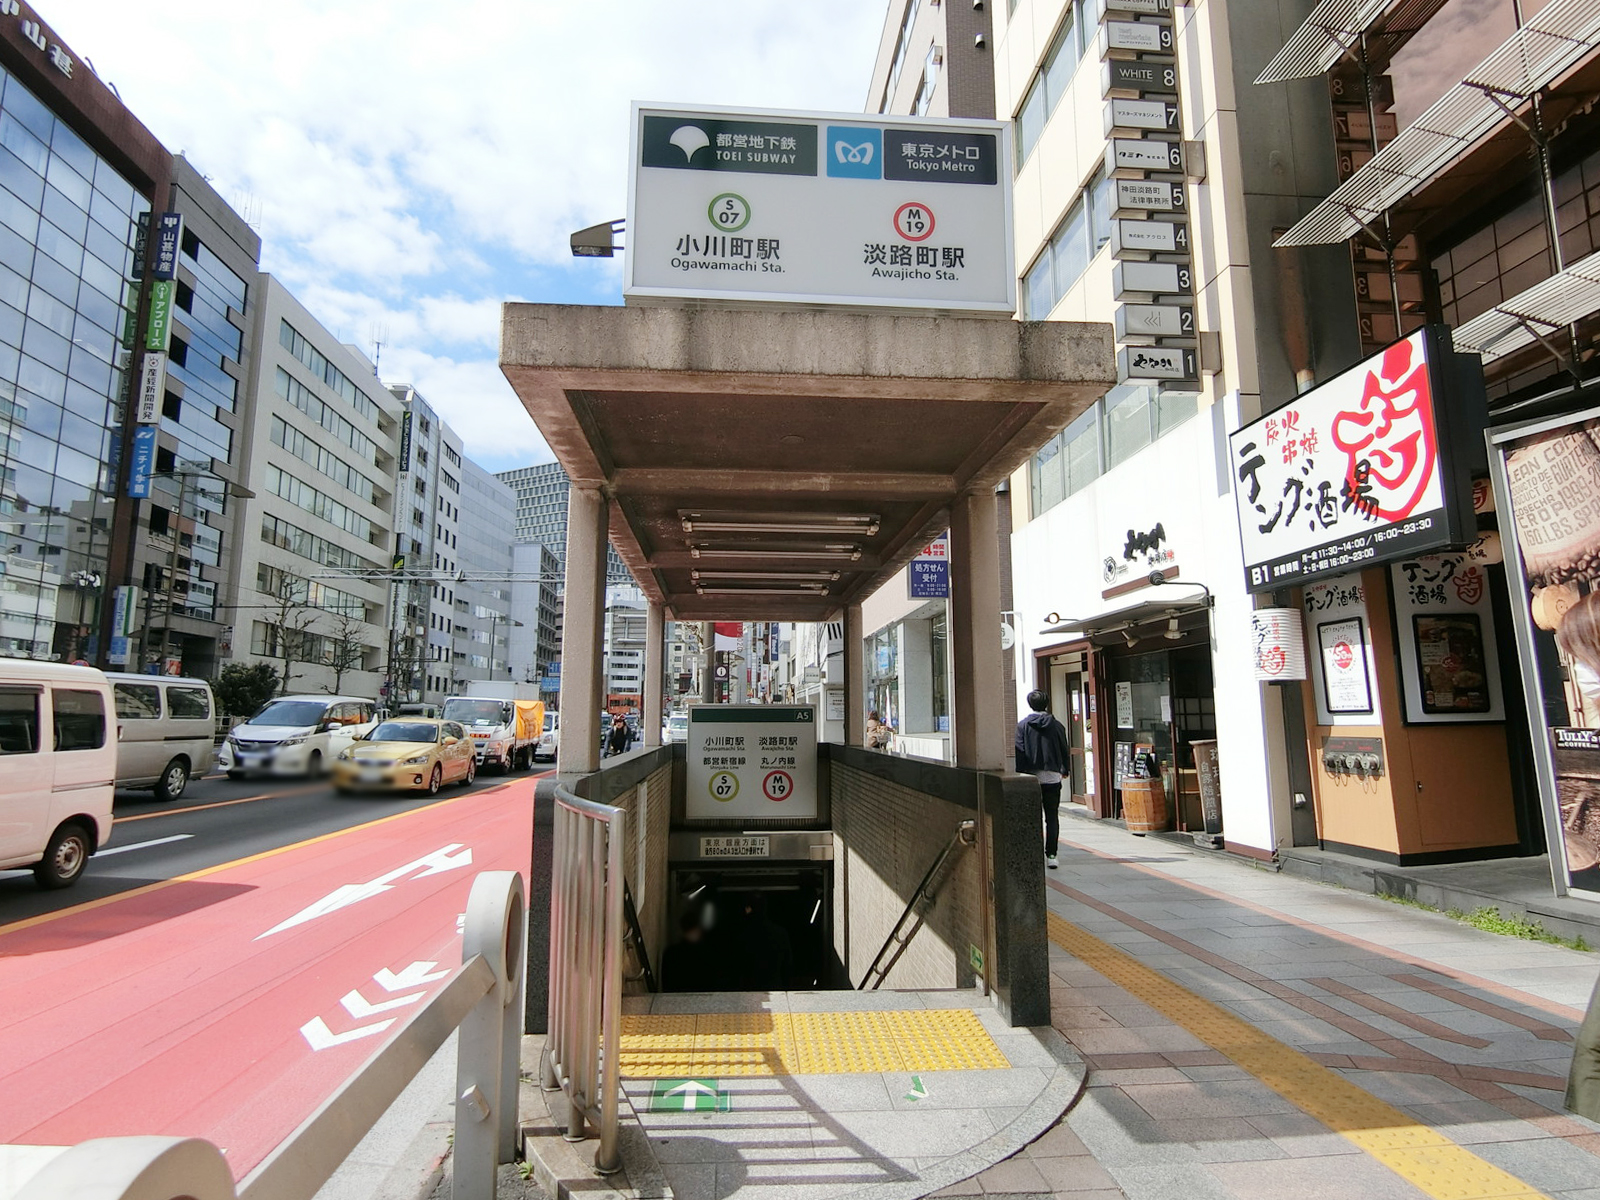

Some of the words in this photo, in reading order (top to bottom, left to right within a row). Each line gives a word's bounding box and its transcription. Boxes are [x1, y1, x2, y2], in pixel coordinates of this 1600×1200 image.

[1161, 31, 1172, 47] 9
[1119, 68, 1153, 80] WHITE
[1163, 69, 1175, 86] 8
[1166, 108, 1177, 125] 7
[716, 133, 796, 150] 都営地下鉄
[716, 150, 742, 161] TOEI
[747, 152, 796, 164] SUBWAY
[901, 143, 980, 160] 東京メトロ
[1169, 148, 1180, 165] 6
[906, 159, 939, 172] Tokyo
[942, 161, 975, 172] Metro
[1121, 185, 1161, 195] 神田淡路町
[1173, 188, 1184, 206] 5
[725, 199, 734, 211] S
[1129, 195, 1170, 205] 法律事務所
[719, 211, 740, 224] 07
[907, 209, 921, 220] M
[906, 221, 925, 233] 19
[1175, 229, 1187, 247] 4
[157, 231, 175, 272] 山甚物産
[676, 234, 780, 260] 小川町駅
[863, 243, 965, 269] 淡路町駅
[670, 257, 757, 272] Ogawamachi
[761, 261, 786, 273] Sta.
[872, 267, 931, 281] Awajicho
[935, 269, 959, 281] Sta.
[1179, 271, 1190, 288] 3
[1181, 312, 1193, 331] 2
[1187, 355, 1194, 373] 1
[1264, 410, 1300, 447] 炭火
[1281, 427, 1320, 466] 串焼
[133, 445, 149, 494] ニチイ学館
[1238, 441, 1381, 535] テング酒場
[915, 563, 944, 573] 処方せん
[1251, 565, 1270, 586] B1
[1273, 561, 1300, 577] 営業時間
[922, 573, 937, 583] 受付
[1305, 585, 1359, 613] テング酒場
[1408, 583, 1447, 605] 酒場
[796, 711, 809, 720] A5
[705, 736, 745, 747] 小川町駅
[758, 736, 798, 747] 淡路町駅
[703, 757, 746, 766] 都営新宿線
[761, 757, 796, 766] 丸ノ内線
[721, 775, 728, 785] S
[773, 775, 783, 784] M
[716, 785, 732, 796] 07
[772, 785, 786, 795] 19
